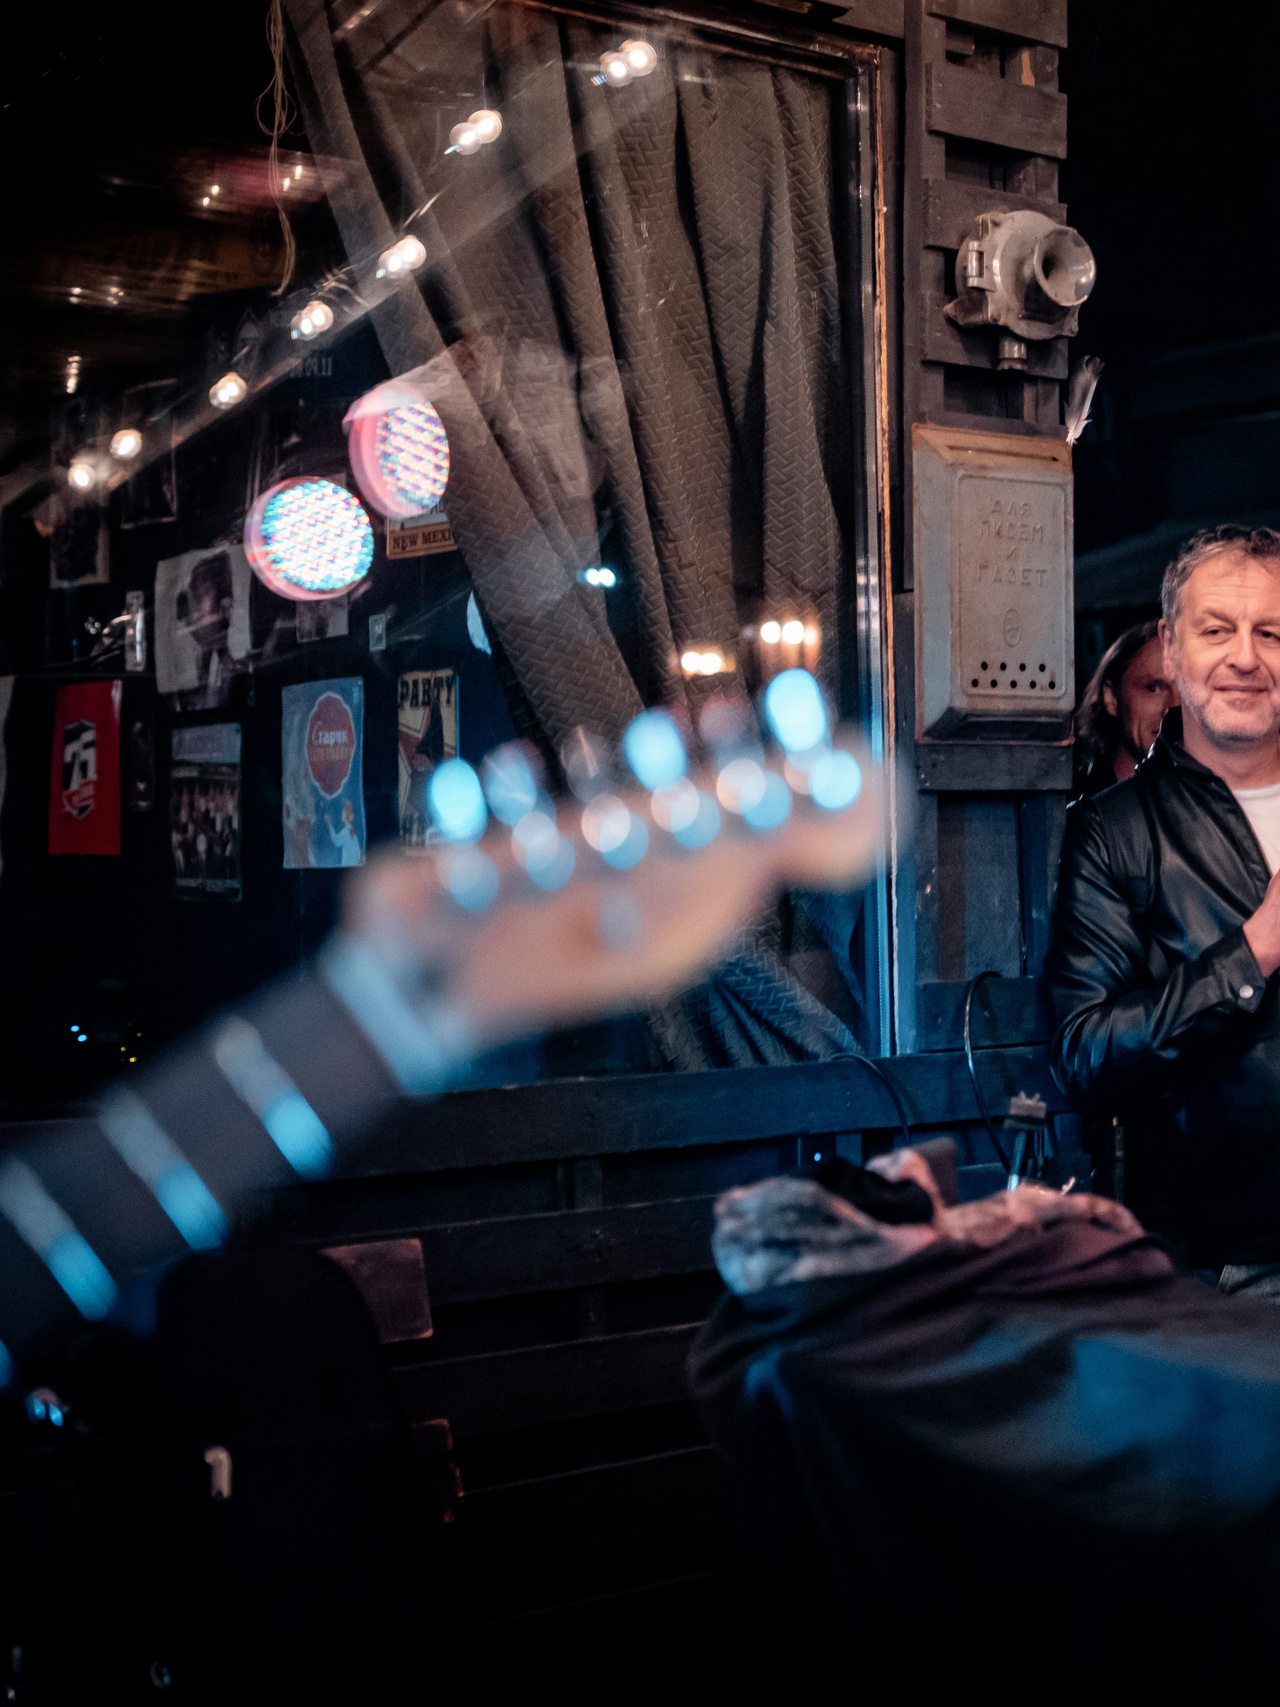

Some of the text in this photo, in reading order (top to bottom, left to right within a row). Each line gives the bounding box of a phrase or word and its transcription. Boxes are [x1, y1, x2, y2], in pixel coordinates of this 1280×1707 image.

[990, 500, 1031, 516] ДЛЯ
[980, 519, 1043, 542] ПИСЕМ
[978, 564, 1047, 586] ГАЗЕТ
[398, 674, 455, 708] PARTY
